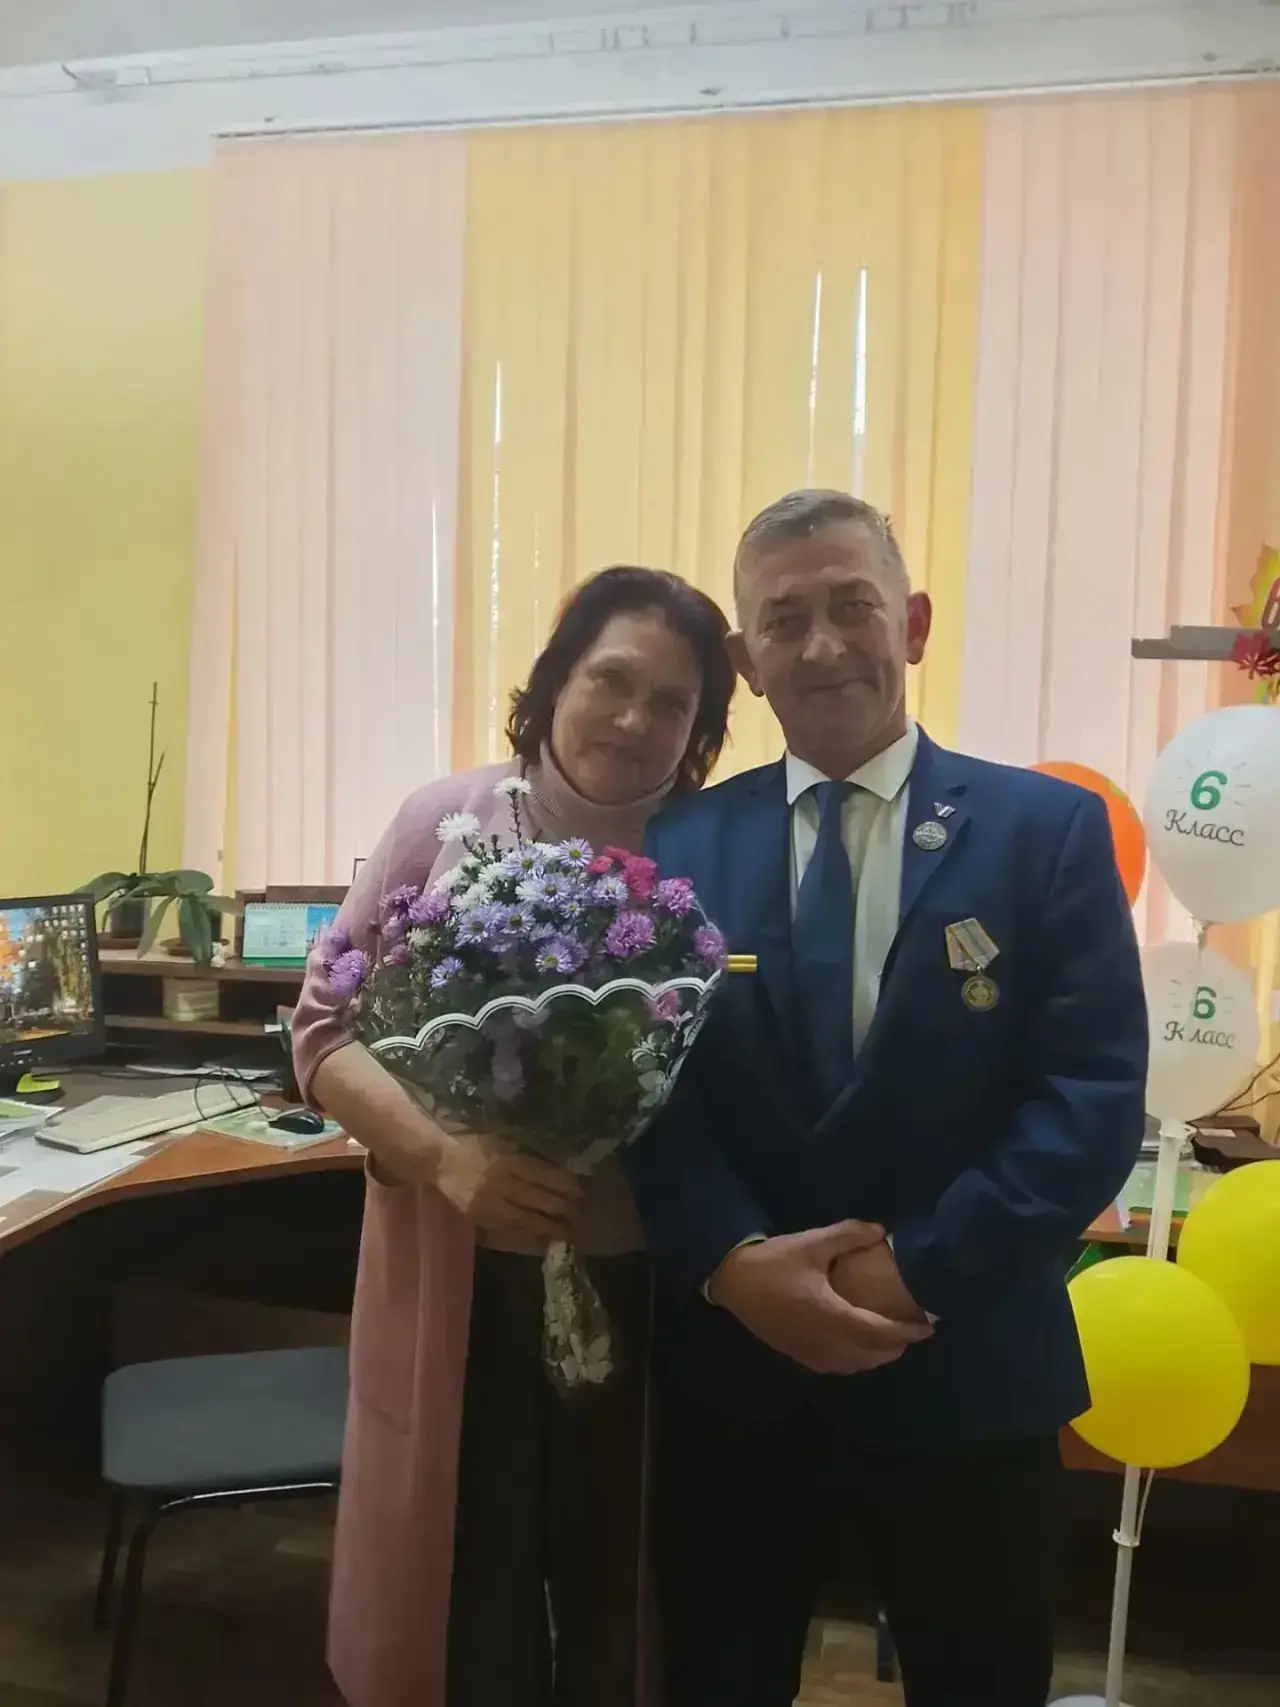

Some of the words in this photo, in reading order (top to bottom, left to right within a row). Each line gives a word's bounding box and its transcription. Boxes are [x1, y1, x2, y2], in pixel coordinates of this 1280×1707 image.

[1190, 770, 1228, 810] 6
[1164, 808, 1245, 846] Класс
[1193, 986, 1217, 1019] 6
[1164, 1020, 1236, 1049] Класс
